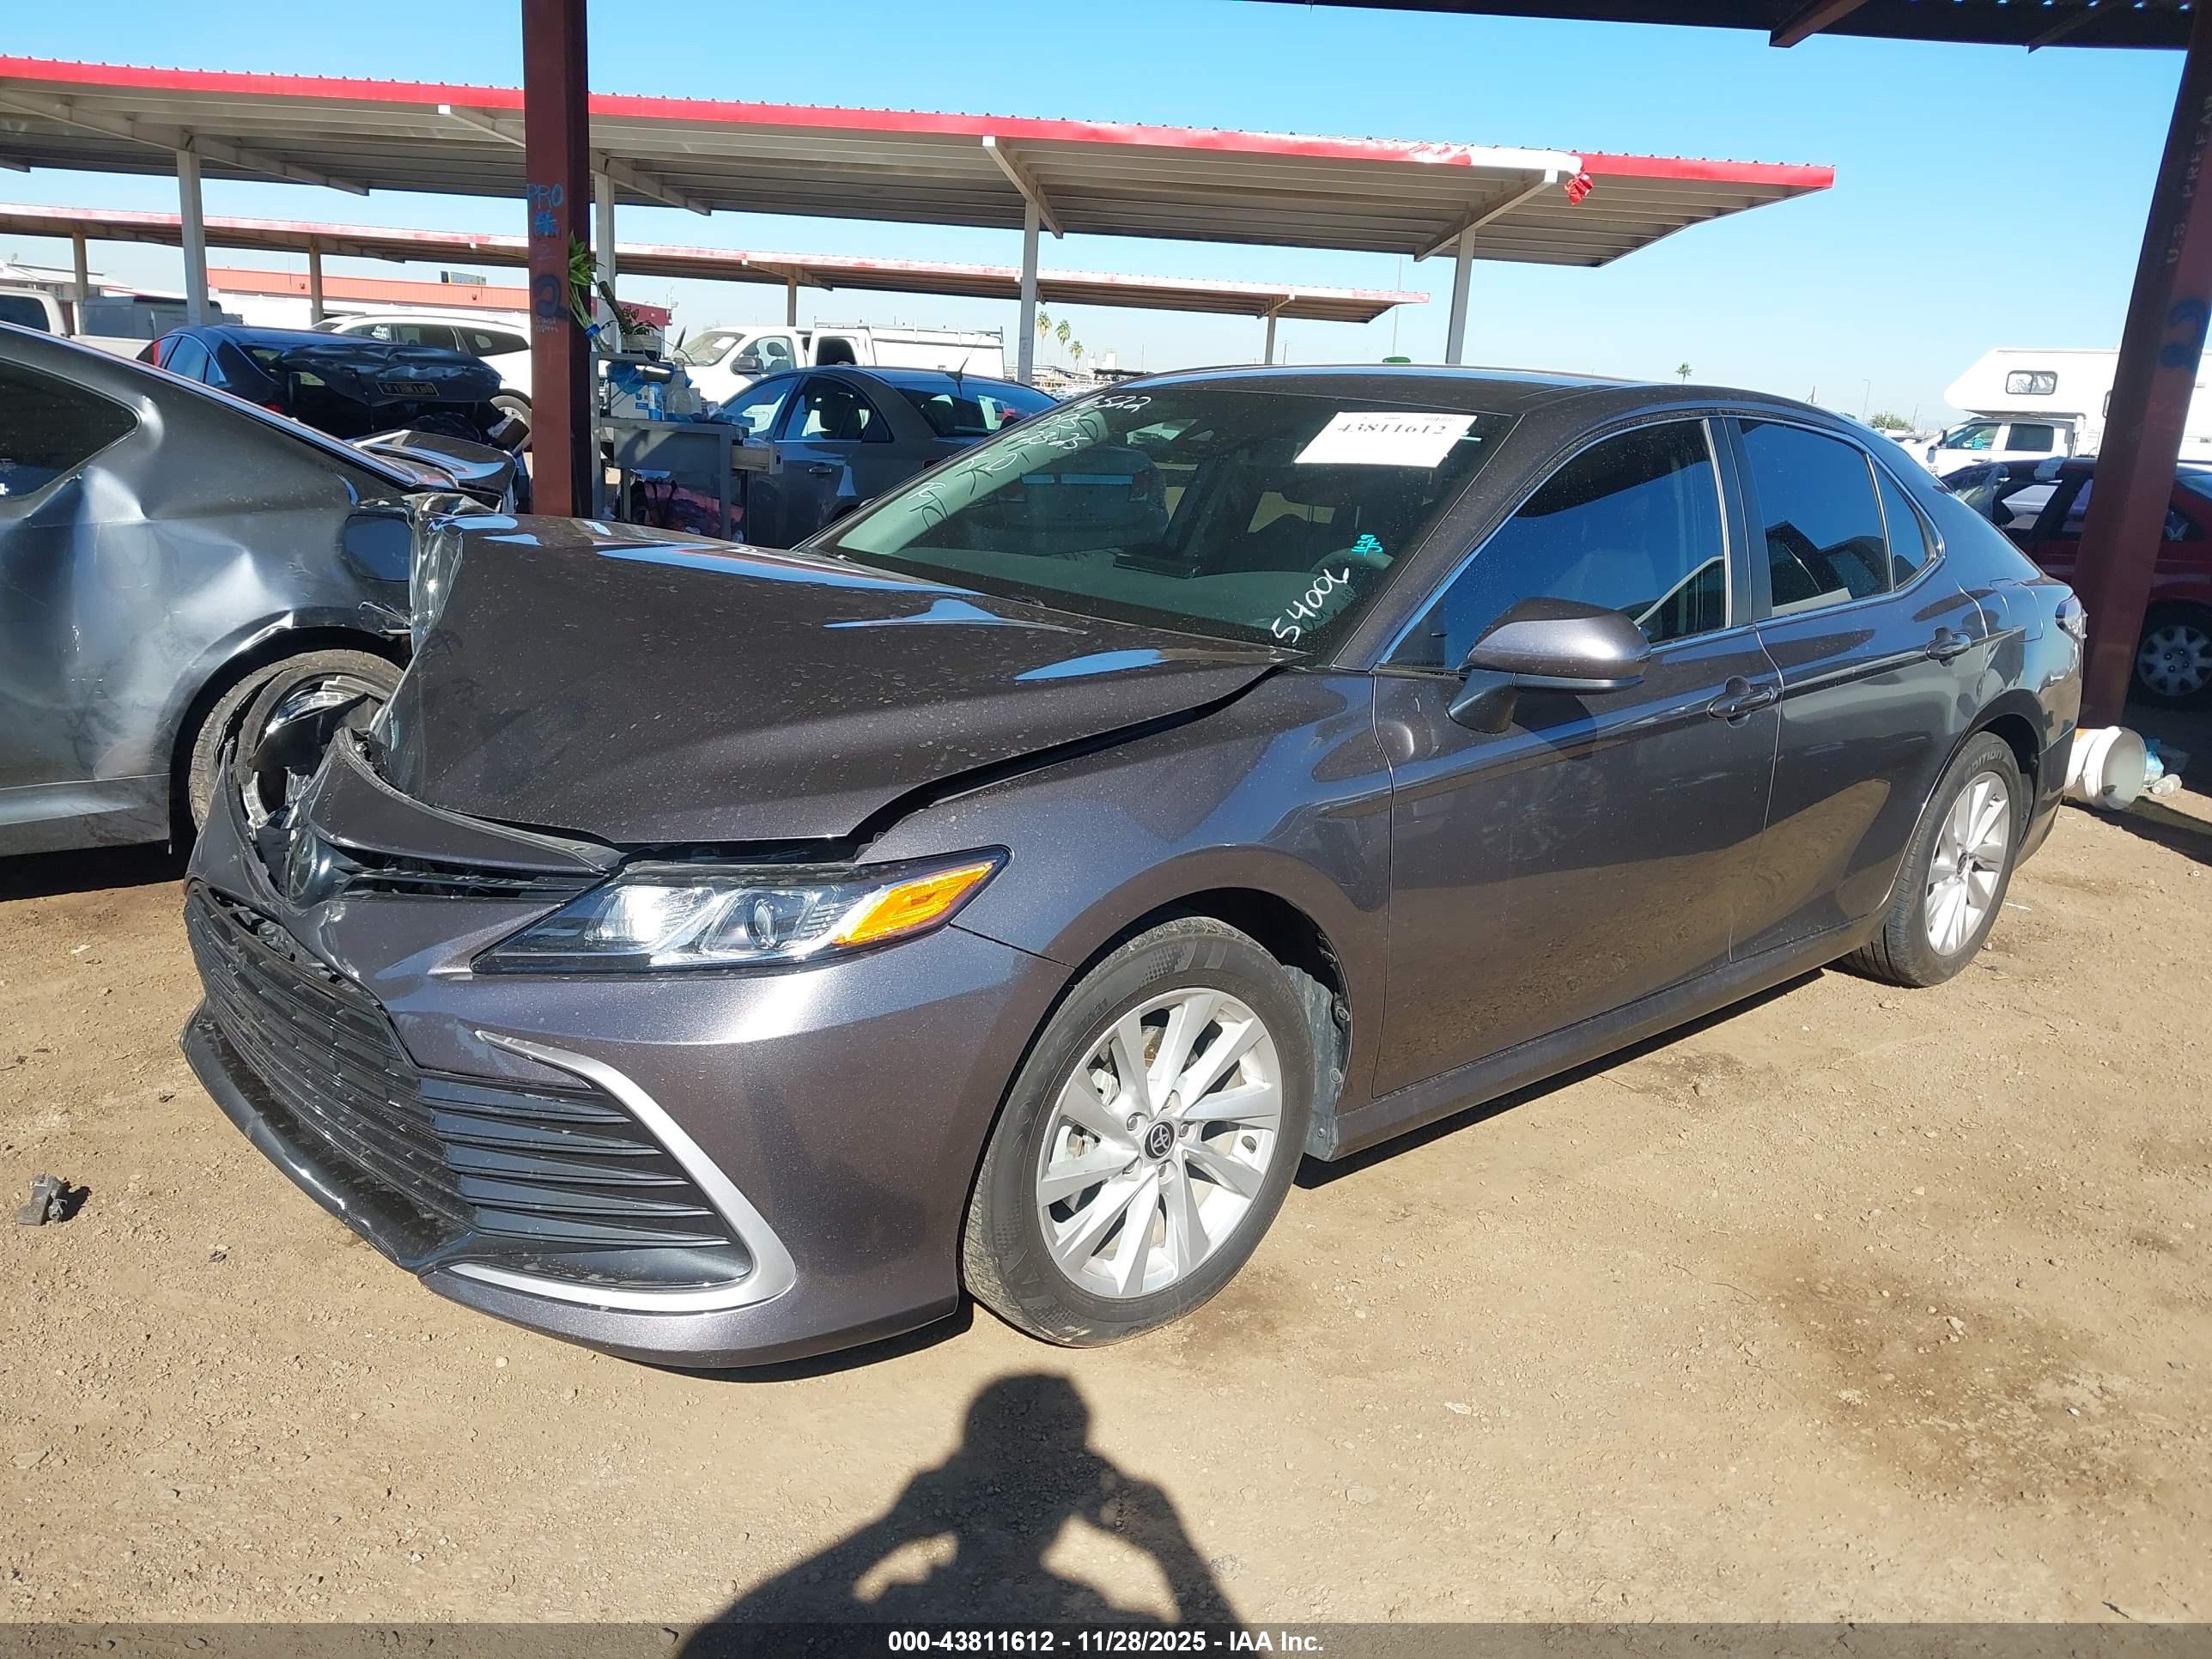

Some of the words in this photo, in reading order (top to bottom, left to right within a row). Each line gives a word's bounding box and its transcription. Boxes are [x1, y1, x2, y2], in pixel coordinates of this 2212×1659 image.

[526, 184, 564, 210] PRO
[533, 275, 568, 321] 2
[1271, 568, 1349, 643] 54006
